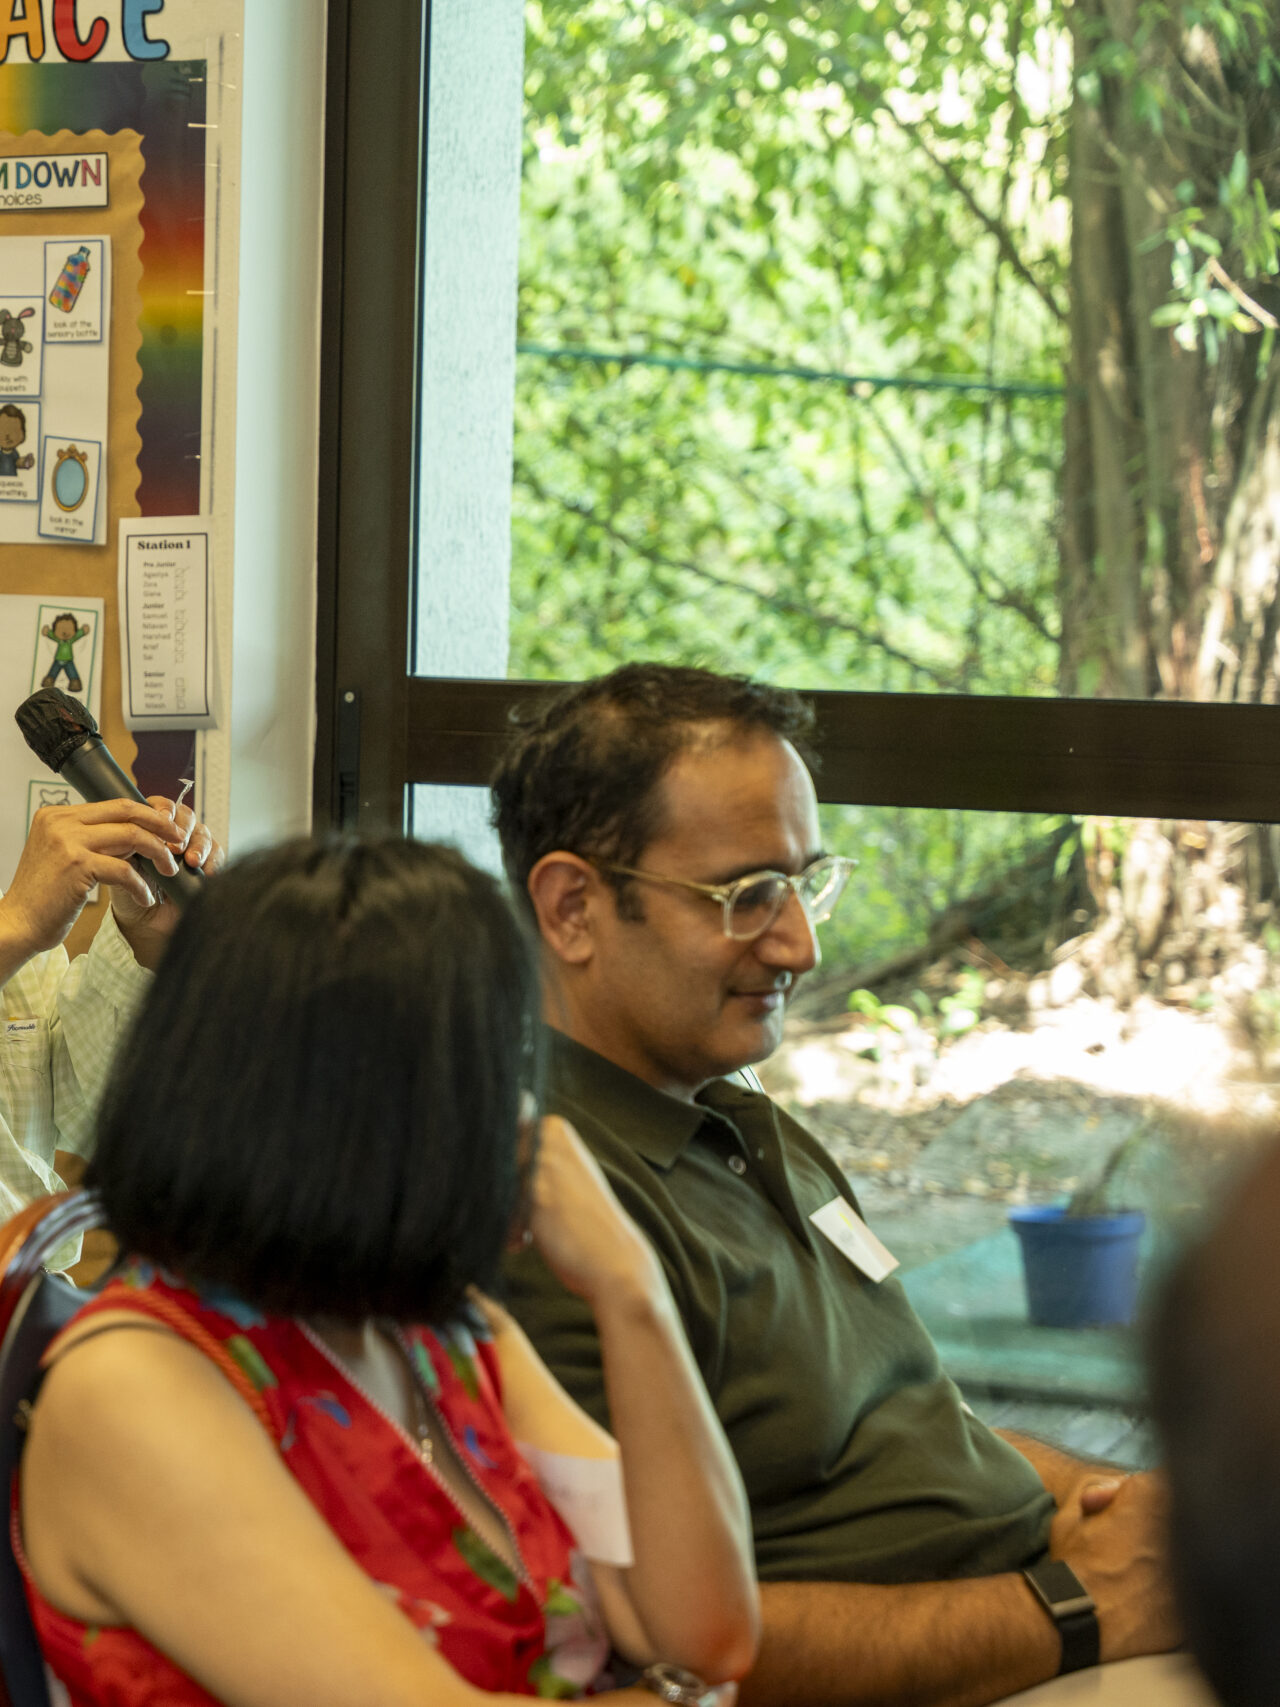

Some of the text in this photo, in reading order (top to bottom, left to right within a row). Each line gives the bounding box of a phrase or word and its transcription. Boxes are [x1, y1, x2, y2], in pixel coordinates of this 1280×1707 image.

[15, 158, 101, 189] DOWN
[137, 539, 191, 551] Station 1
